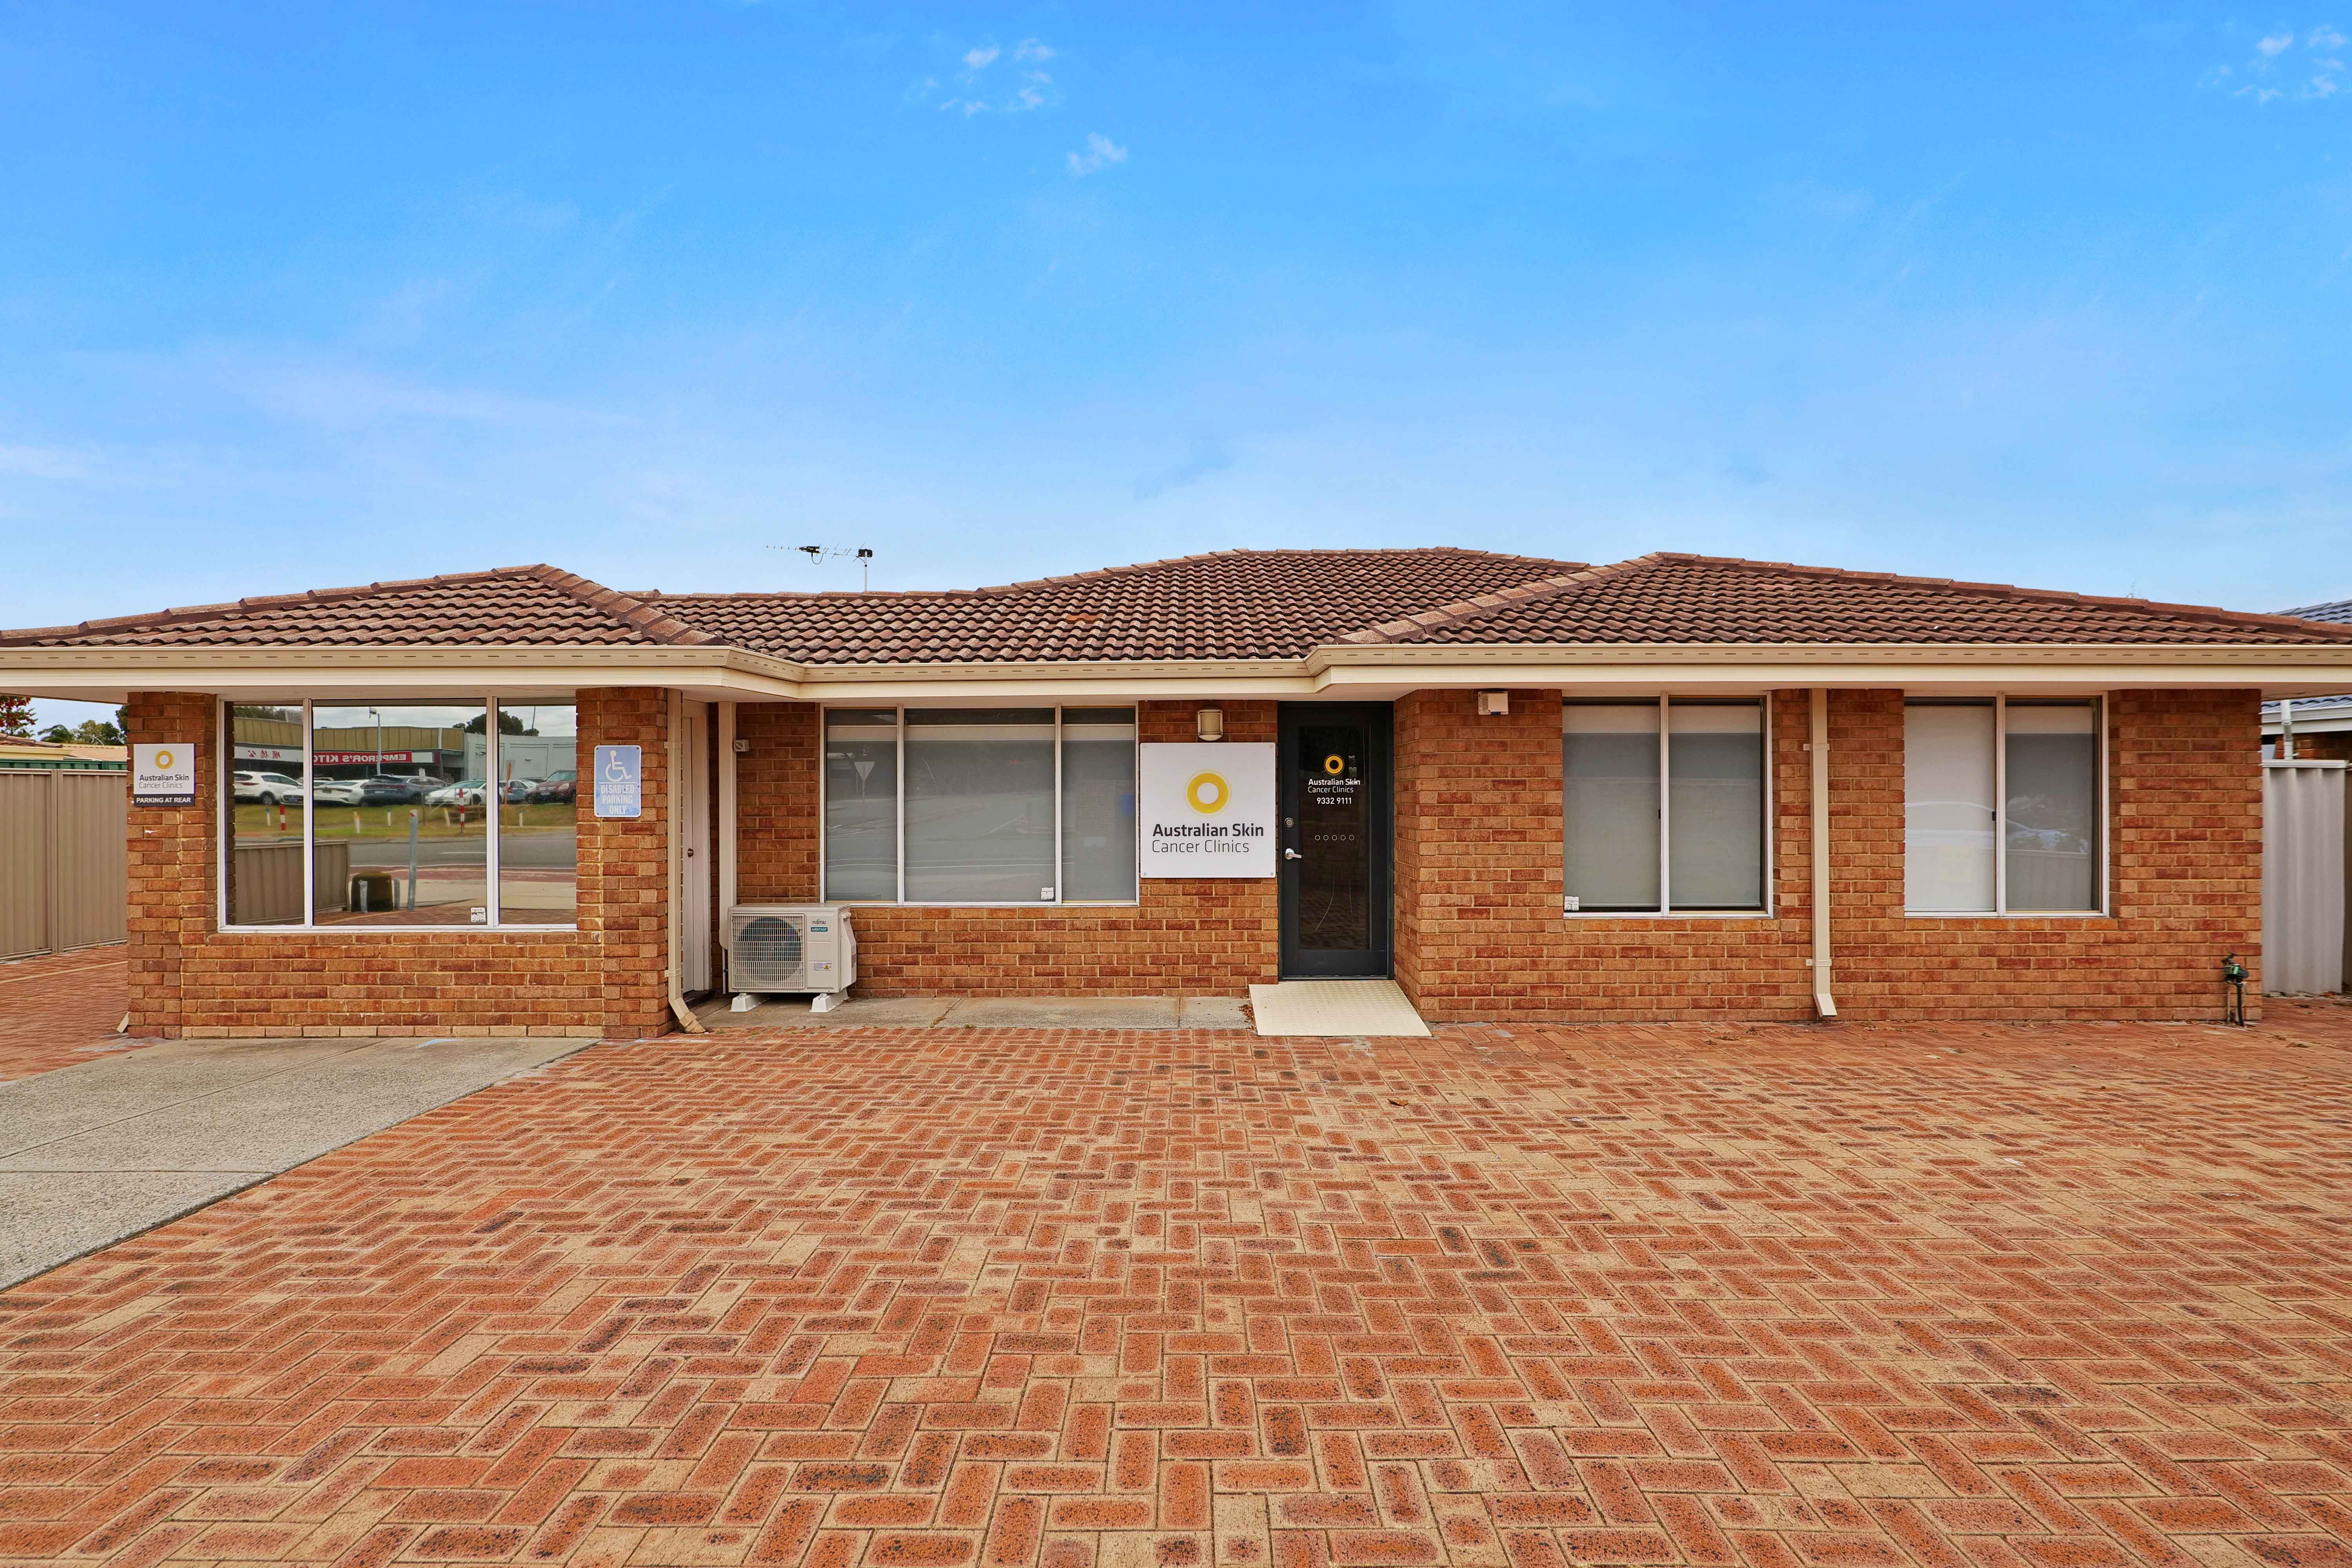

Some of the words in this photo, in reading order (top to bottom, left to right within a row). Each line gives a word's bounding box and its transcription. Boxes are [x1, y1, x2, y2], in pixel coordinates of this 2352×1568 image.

[601, 784, 634, 793] DISABLED
[602, 795, 633, 804] PARKING
[610, 806, 626, 814] ONLY
[1152, 823, 1228, 837] Australian
[1232, 823, 1264, 837] Skin
[1152, 840, 1200, 853] Cancer
[1204, 839, 1249, 853] Clinics
